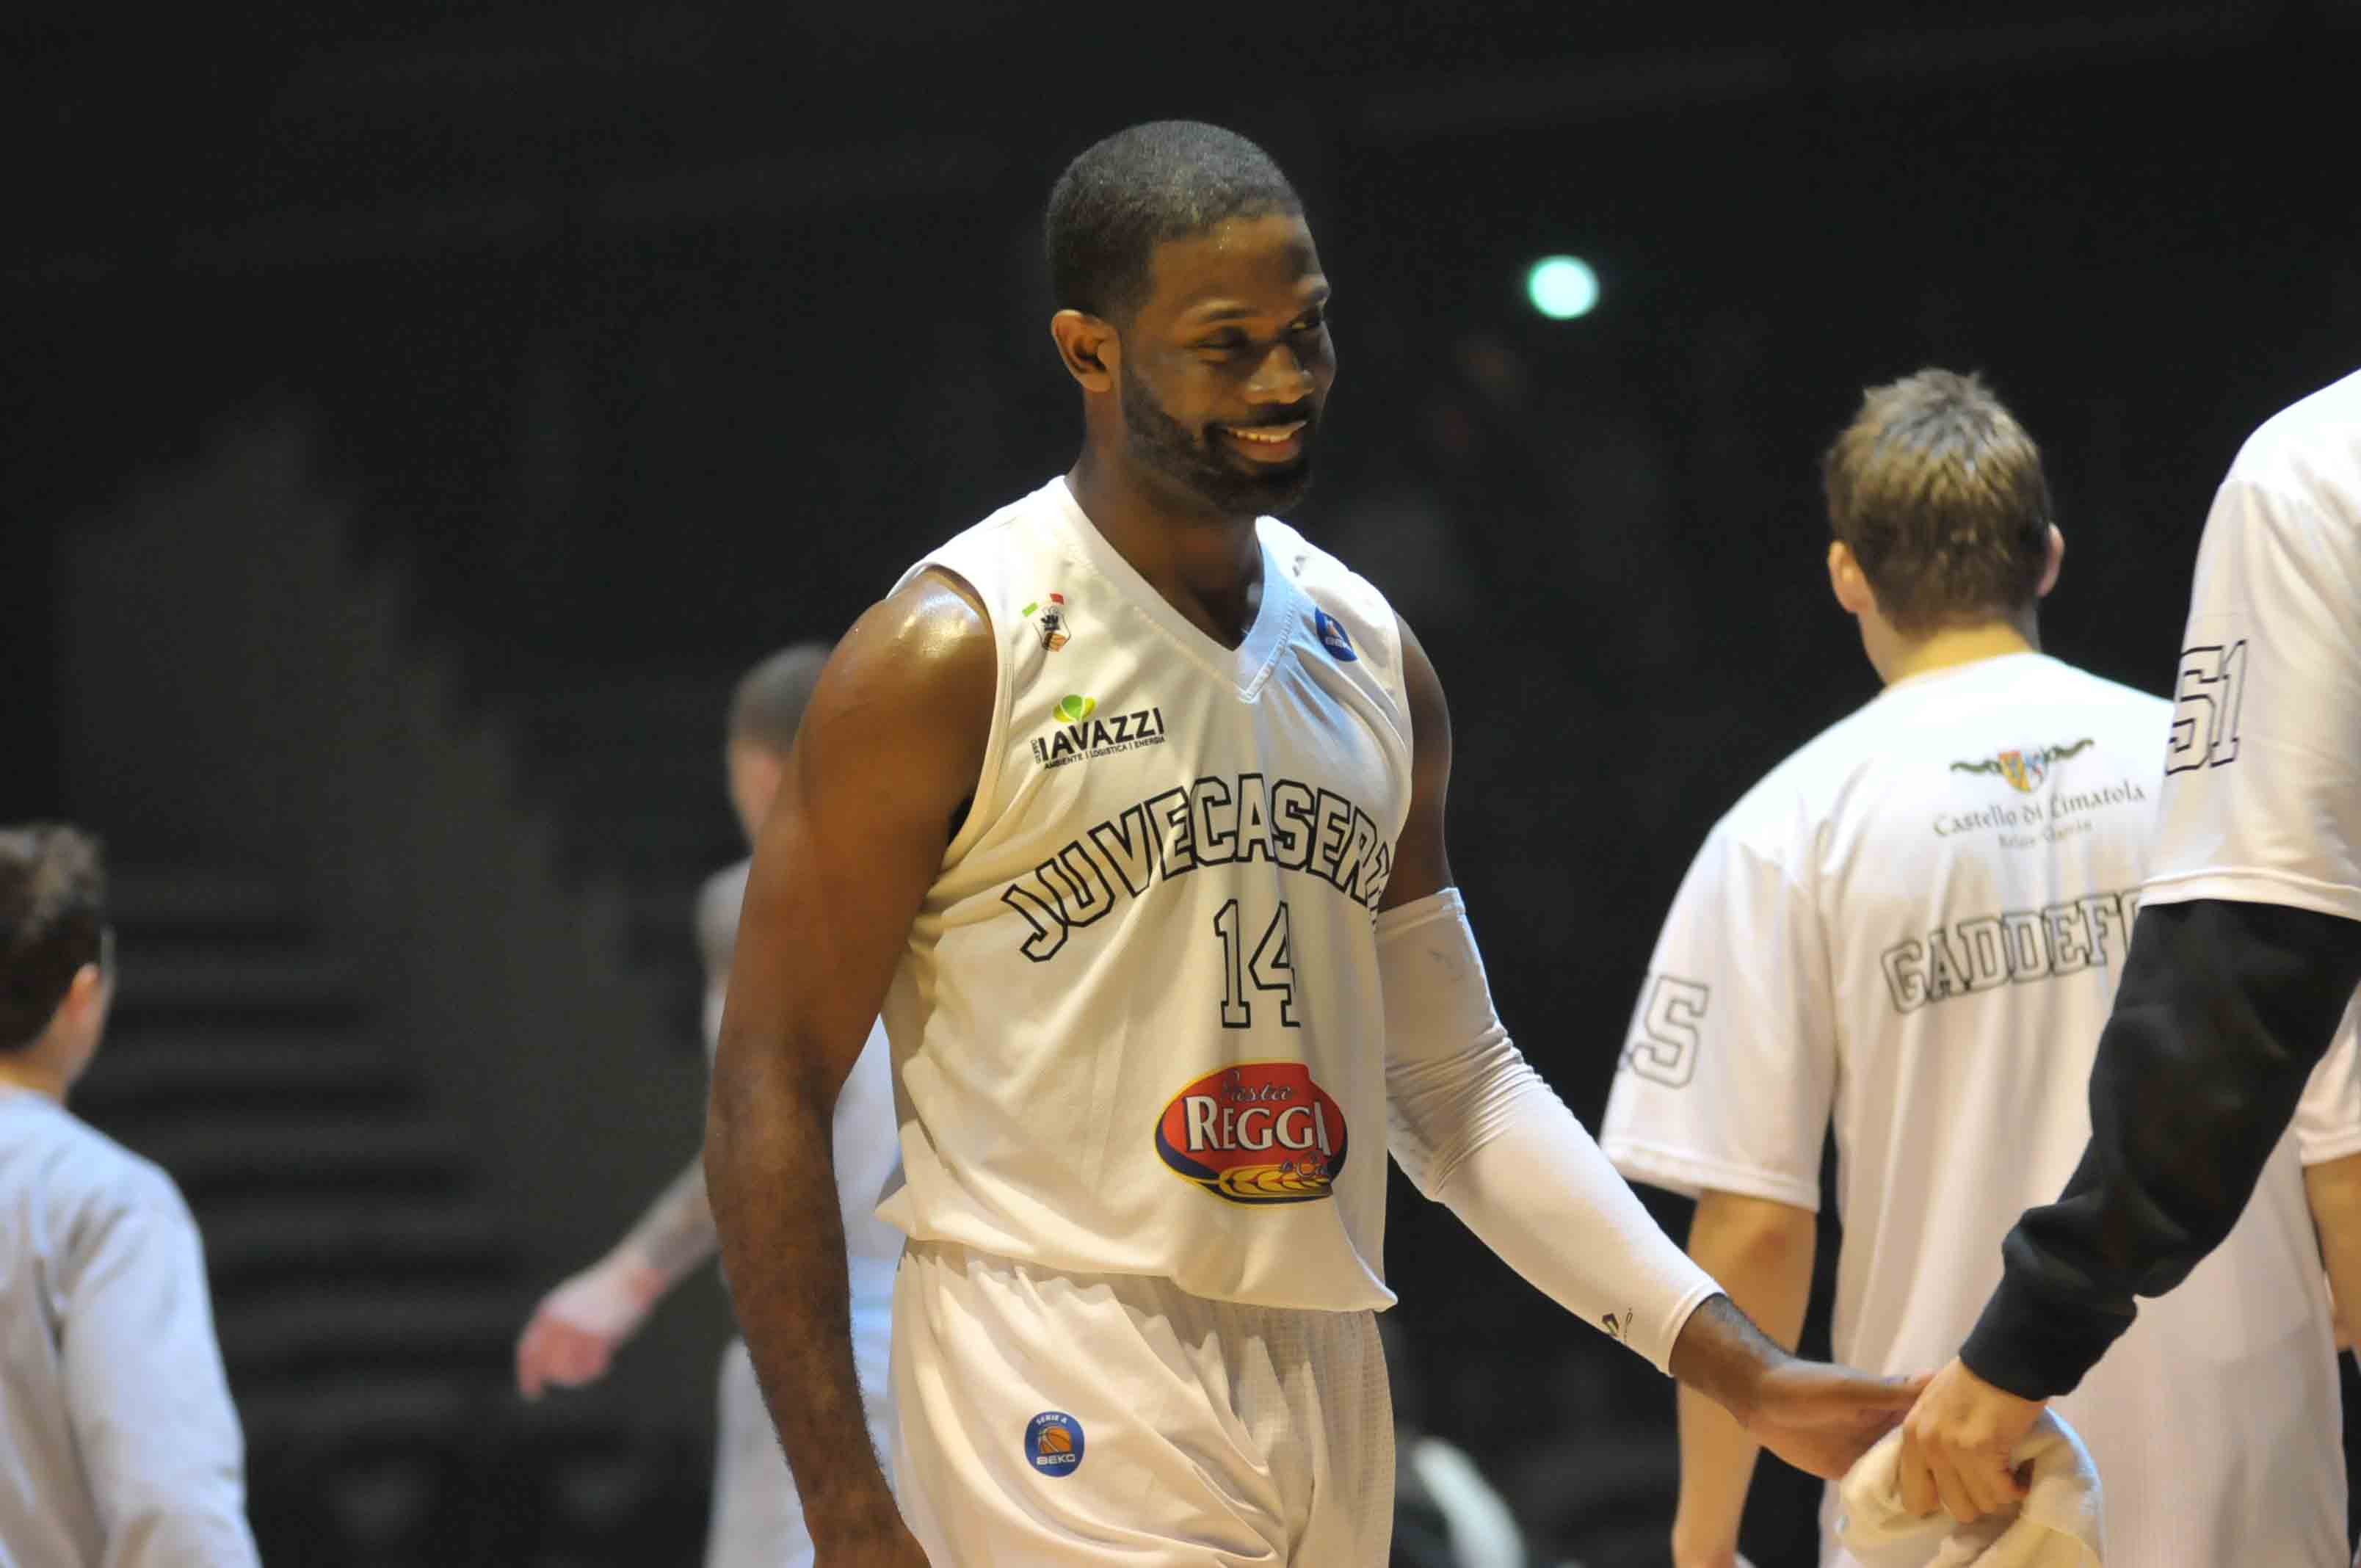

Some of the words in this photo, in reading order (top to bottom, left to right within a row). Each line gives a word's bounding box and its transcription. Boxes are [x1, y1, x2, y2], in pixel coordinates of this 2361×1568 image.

[1037, 707, 1164, 761] IAVAZZI
[1045, 754, 1083, 770] AMBIENTE
[1090, 744, 1128, 758] LOGISTICA
[1134, 736, 1165, 749] ENERGIA
[1933, 804, 2017, 837] Castello
[2023, 803, 2044, 823] di
[1214, 899, 1301, 1029] 14
[1036, 1453, 1076, 1465] BEKO
